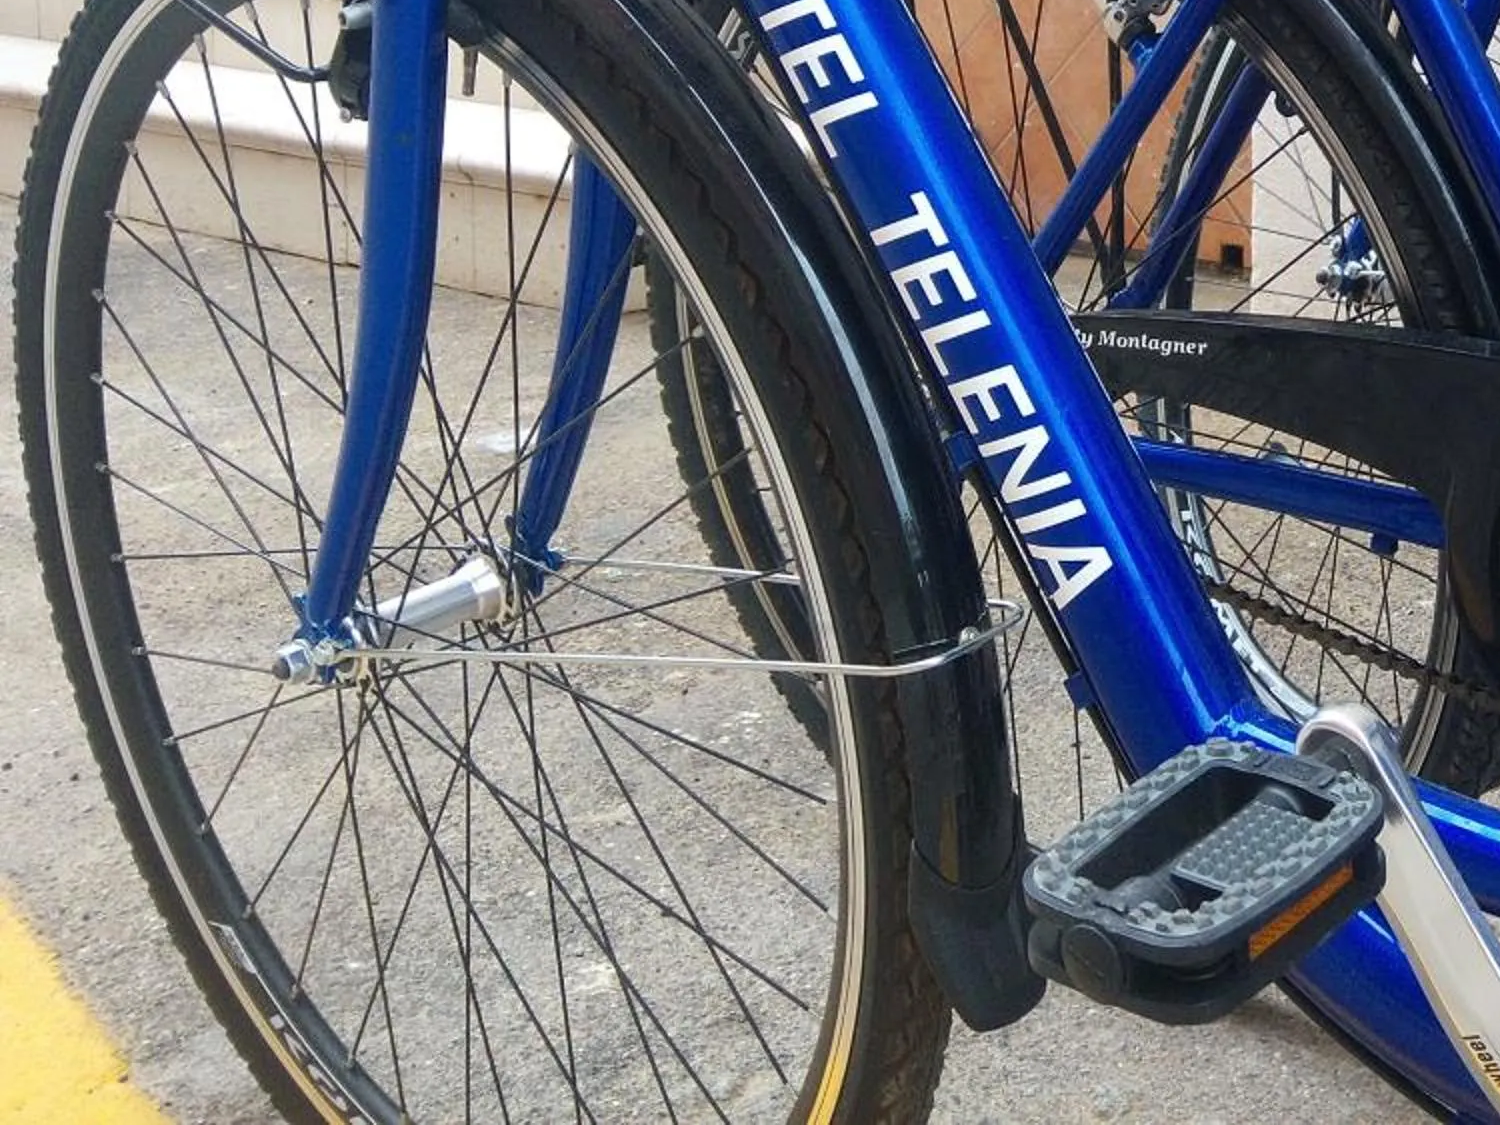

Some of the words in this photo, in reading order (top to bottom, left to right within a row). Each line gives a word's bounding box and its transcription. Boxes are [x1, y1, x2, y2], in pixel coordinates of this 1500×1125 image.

[869, 192, 1114, 611] TELENIA
[1074, 329, 1093, 350] y
[1097, 330, 1208, 356] Montagner
